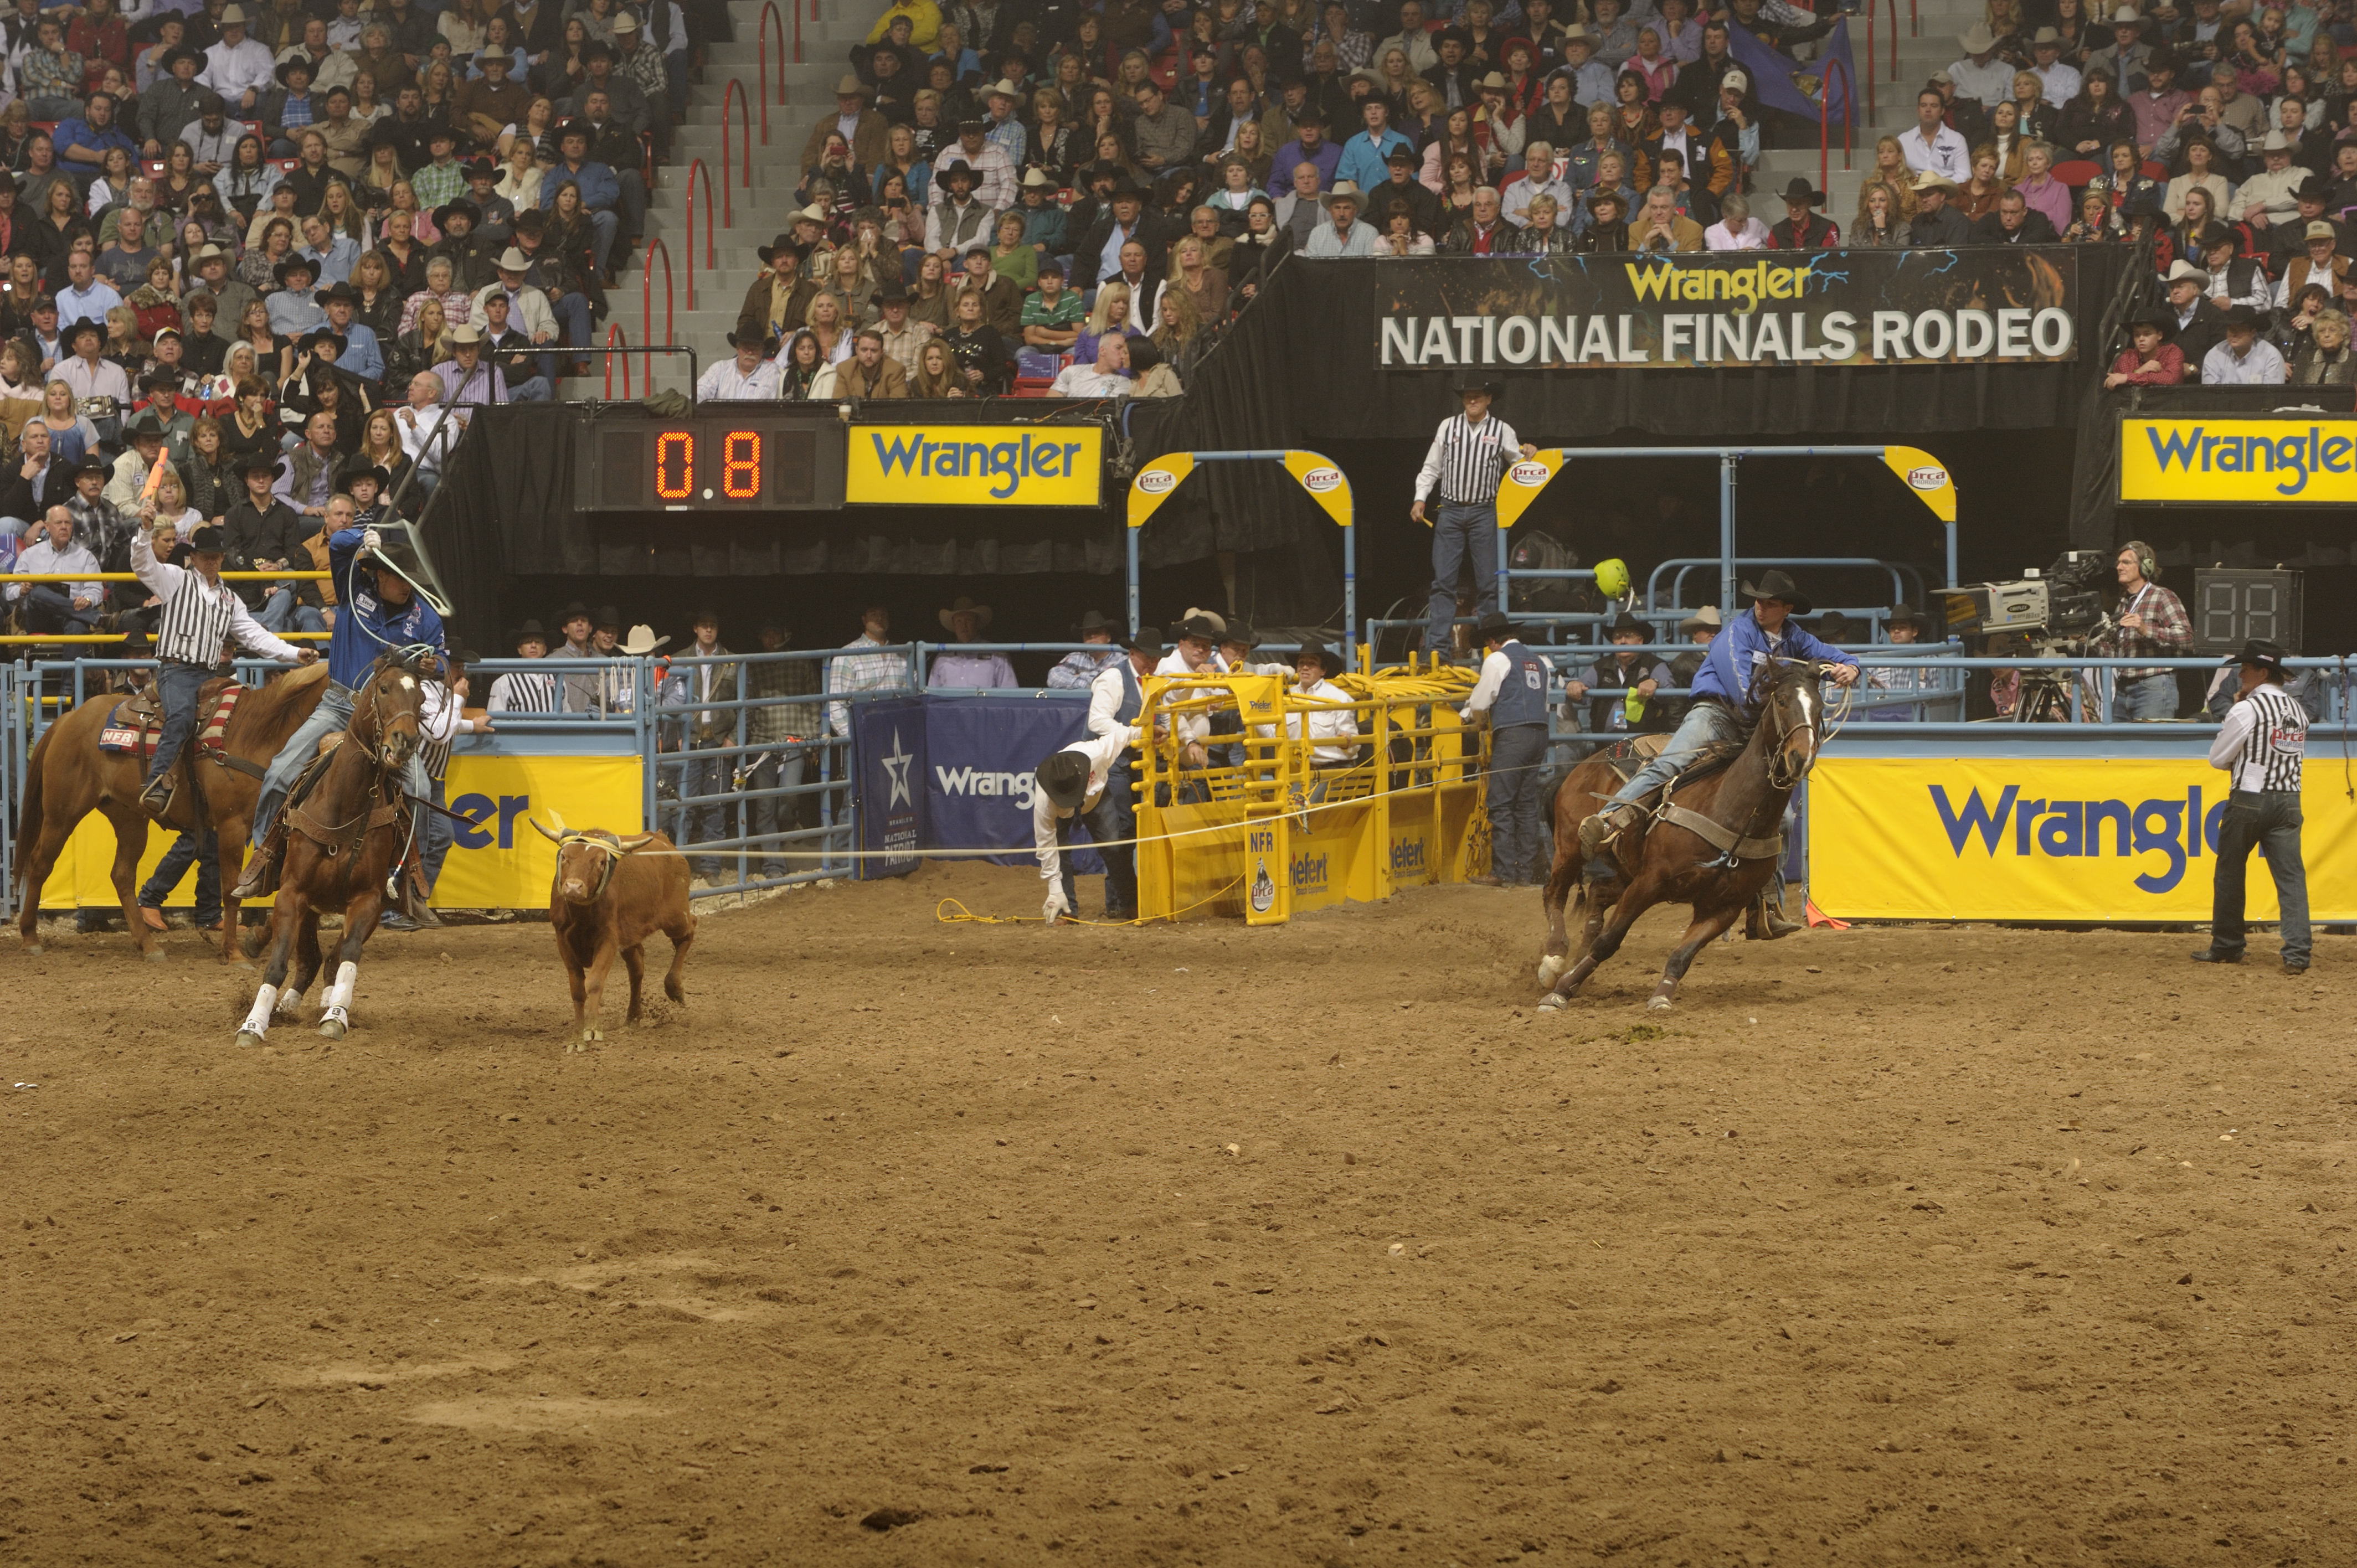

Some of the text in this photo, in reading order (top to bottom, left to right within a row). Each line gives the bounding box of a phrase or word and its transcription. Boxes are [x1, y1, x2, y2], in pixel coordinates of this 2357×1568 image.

[1624, 261, 1810, 317] Wrangler
[1381, 307, 2074, 364] NATIONAL FINALS RODEO
[871, 434, 1082, 498] Wrangler
[2146, 427, 2357, 496] Wrangle
[1141, 474, 1171, 488] prca
[1307, 472, 1338, 487] prca
[1514, 468, 1546, 480] prca
[1909, 471, 1945, 484] prca
[1249, 700, 1272, 709] Priefert
[103, 731, 132, 742] NFR
[935, 766, 1037, 810] Wrang
[884, 829, 917, 843] NATIONAL
[1250, 832, 1273, 853] NFR
[1927, 785, 2266, 894] Wrangl
[1390, 837, 1424, 870] iefert
[1289, 851, 1327, 886] riefert
[1252, 883, 1273, 905] prca
